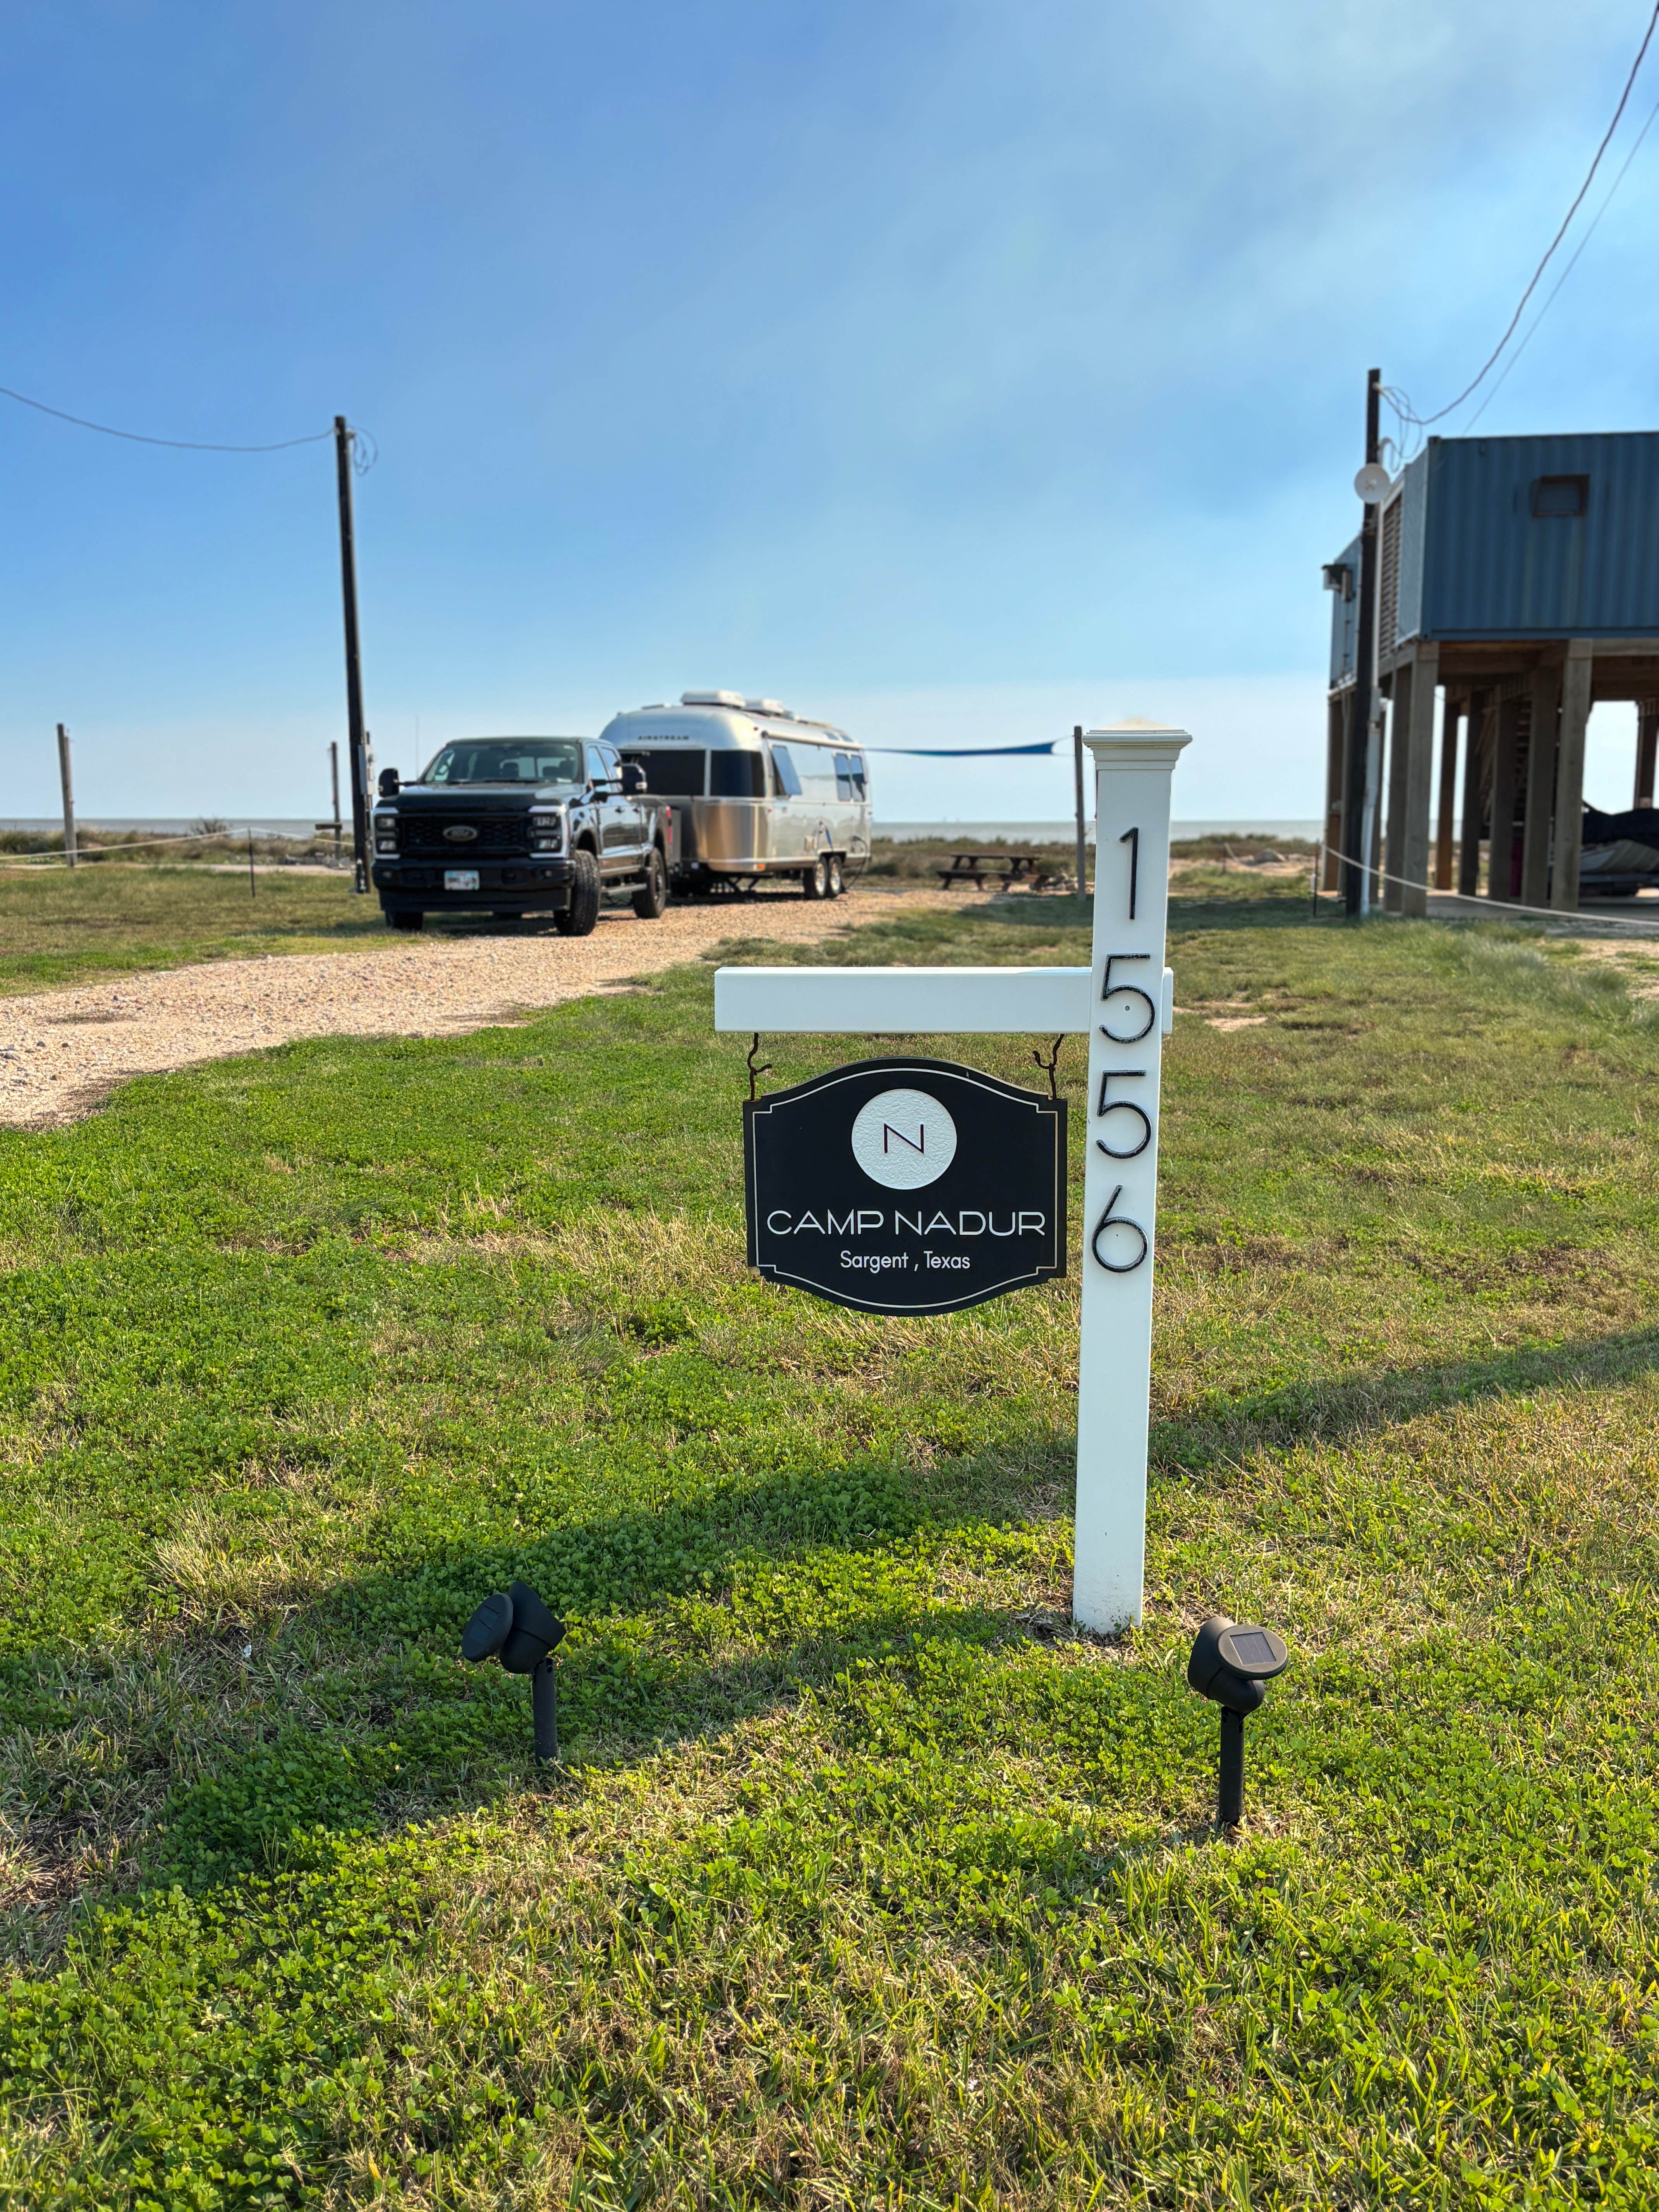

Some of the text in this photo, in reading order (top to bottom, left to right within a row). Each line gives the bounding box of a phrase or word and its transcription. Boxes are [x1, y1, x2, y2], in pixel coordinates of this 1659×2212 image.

[884, 1123, 924, 1154] N
[767, 1209, 1045, 1236] CAMP NADUR
[923, 1251, 970, 1269] Texas
